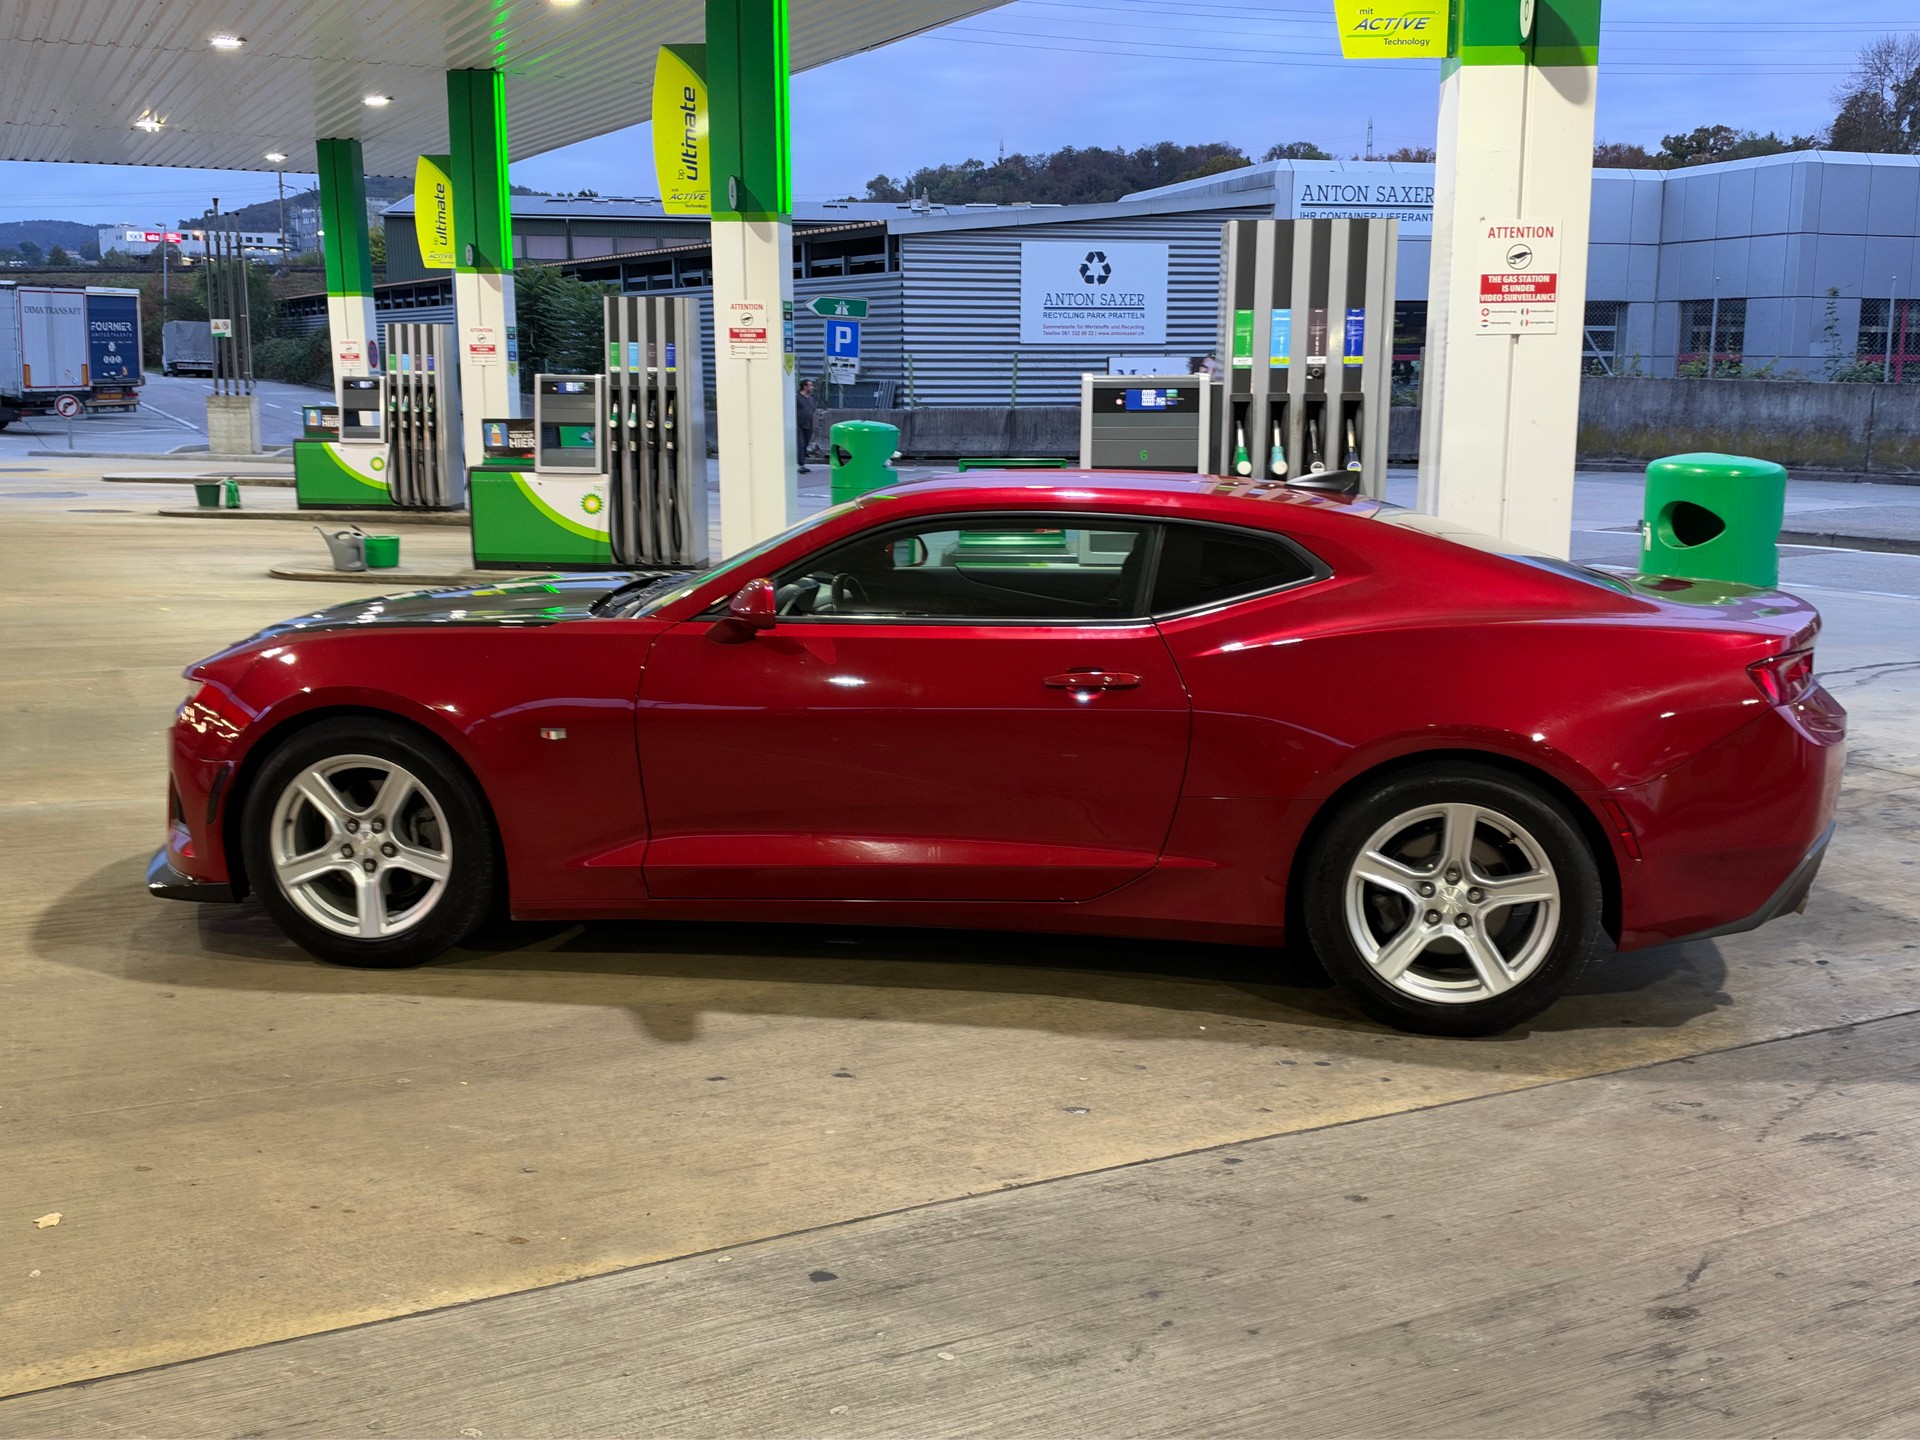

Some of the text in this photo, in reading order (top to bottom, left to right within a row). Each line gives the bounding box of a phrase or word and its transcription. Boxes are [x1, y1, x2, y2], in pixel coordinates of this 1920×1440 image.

[1359, 7, 1374, 15] mit
[1353, 17, 1431, 31] ACTIVE
[1384, 38, 1431, 46] Technology
[680, 86, 698, 181] ultimate
[668, 193, 708, 201] ACTIVE
[1301, 184, 1434, 203] ANTON SAXER
[434, 183, 448, 246] ultimate
[1300, 211, 1317, 219] IHR
[1488, 226, 1555, 238] ATTENTION
[1488, 275, 1550, 283] THE GAS STATION
[1501, 284, 1536, 292] IS UNDER
[1043, 292, 1145, 306] ANTON SAXER
[1480, 293, 1556, 301] VIDEO SURVEILLANCE
[45, 306, 68, 315] TRANS
[91, 321, 132, 331] FOURNIER
[835, 326, 851, 353] P
[508, 438, 536, 448] HIER
[1140, 449, 1148, 460] 6
